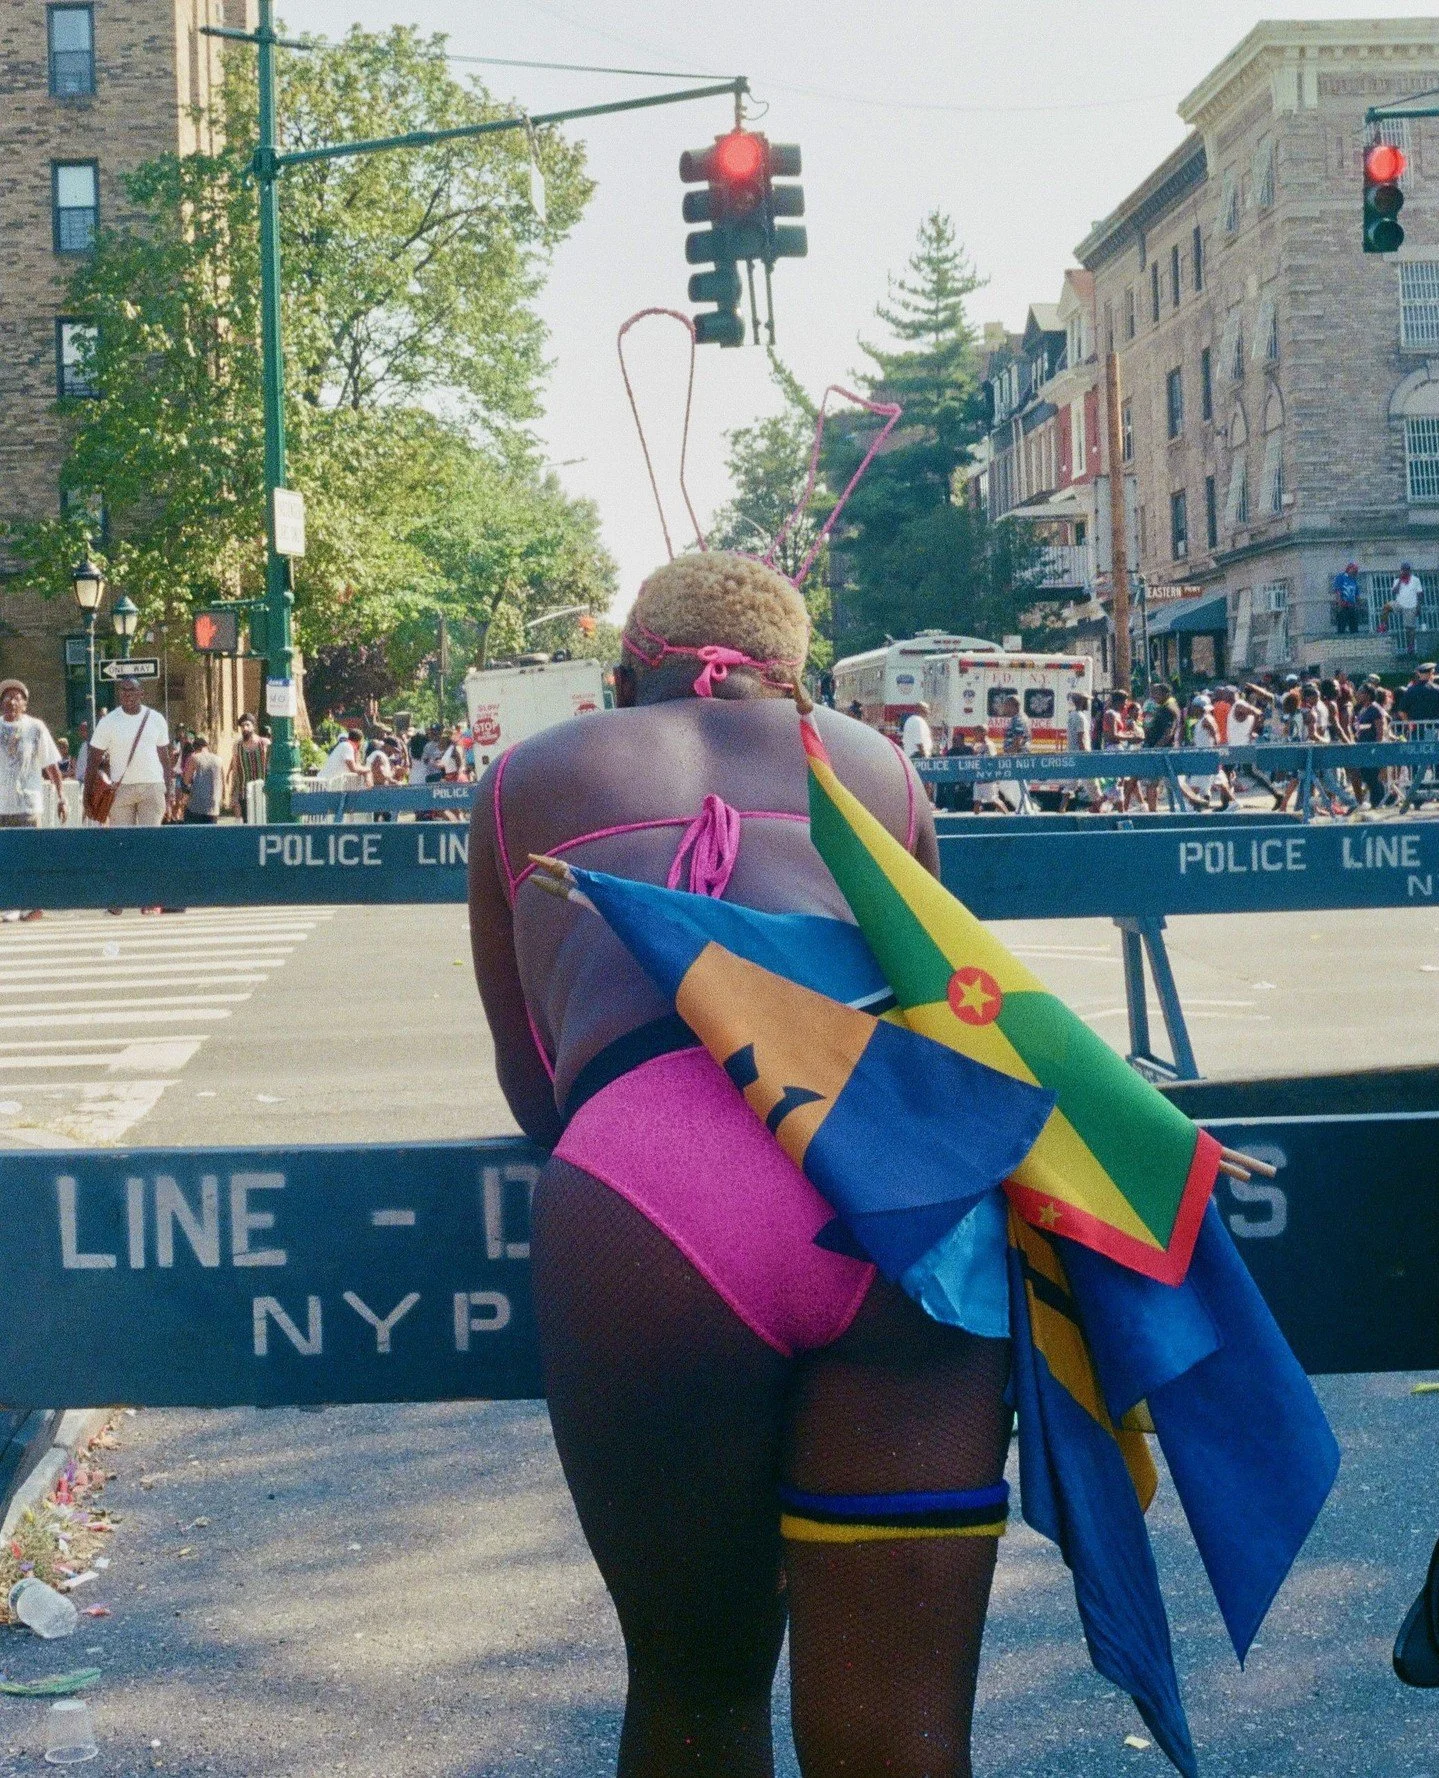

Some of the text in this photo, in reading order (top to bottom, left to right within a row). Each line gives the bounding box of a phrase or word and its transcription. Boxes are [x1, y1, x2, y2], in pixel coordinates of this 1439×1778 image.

[1147, 585, 1181, 598] EASTERN
[109, 664, 151, 674] ONE WAY
[473, 720, 498, 732] STOP
[915, 760, 949, 771] POLICE
[958, 760, 981, 770] LINE
[998, 760, 1012, 769] DO
[1016, 759, 1037, 769] NOT
[1040, 757, 1076, 768] CROSS
[433, 788, 469, 799] POLICE
[258, 833, 382, 867] POLICE
[1179, 834, 1421, 874] POLICE LINE
[1407, 874, 1439, 897] N
[56, 1172, 288, 1270] LINE
[371, 1209, 416, 1227] -
[252, 1290, 512, 1356] NYP
